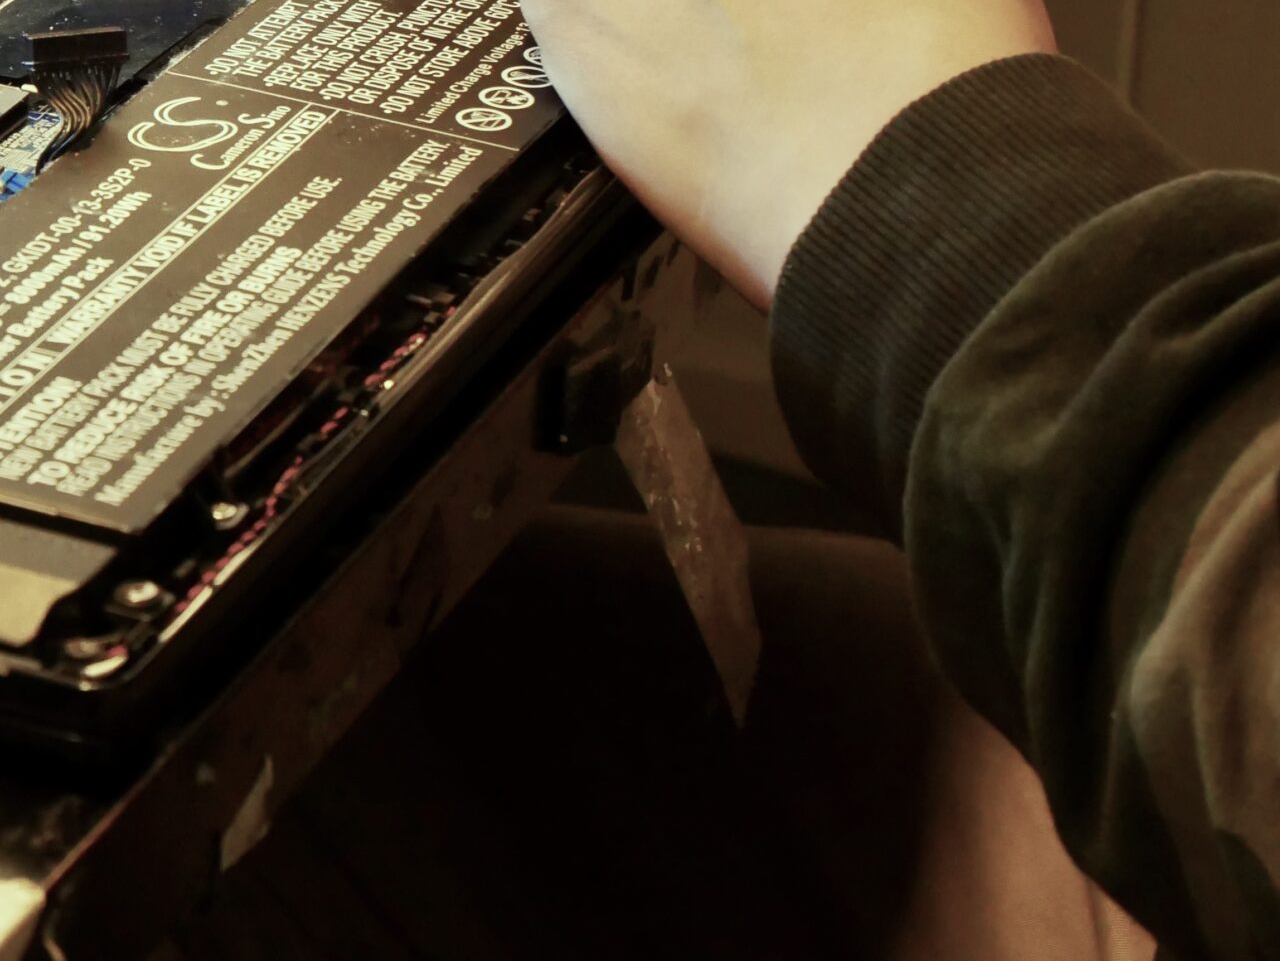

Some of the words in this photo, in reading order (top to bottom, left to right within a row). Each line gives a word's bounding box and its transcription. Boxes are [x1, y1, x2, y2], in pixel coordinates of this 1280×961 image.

[222, 38, 262, 59] NOT
[247, 0, 309, 40] ATTEMPT
[421, 26, 451, 39] IN
[433, 7, 473, 29] FIRE
[232, 57, 273, 77] THE
[254, 19, 317, 60] BATTERY
[263, 43, 329, 86] REPLACE
[312, 21, 354, 45] ONLY
[337, 0, 381, 23] WITH
[289, 71, 330, 92] FOR
[311, 50, 354, 71] THIS
[336, 9, 403, 52] PRODUCT.
[336, 61, 375, 84] NOT
[359, 31, 418, 64] CRUSH,
[396, 75, 435, 97] NOT
[418, 46, 469, 77] STORE
[452, 17, 501, 49] ABOVE
[407, 36, 437, 51] OF
[363, 49, 425, 90] DISPOSE
[347, 88, 382, 104] OR
[415, 91, 461, 124] Limited
[449, 63, 492, 93] Charge
[190, 128, 266, 171] Cameron
[237, 106, 291, 129] Sino
[247, 111, 326, 169] REMOVED
[232, 168, 263, 182] IS
[389, 139, 450, 182] BATTERY.
[186, 184, 249, 224] LABEL
[299, 176, 342, 199] USE.
[368, 179, 407, 200] THE
[79, 192, 152, 242] 91.20Wh
[170, 221, 199, 237] IF
[258, 196, 318, 237] BEFORE
[336, 199, 386, 232] USING
[132, 236, 186, 268] VOID
[205, 235, 275, 285] CHARGED
[294, 229, 354, 272] BEFORE
[6, 286, 80, 337] Battery
[62, 257, 114, 289] Pack
[45, 265, 148, 345] WARRANTY
[169, 282, 221, 316] FULLY
[261, 268, 314, 303] GUIDE
[95, 415, 203, 506] Manufacture
[275, 273, 351, 331] HENZENS
[334, 209, 421, 274] Technology
[402, 189, 443, 210] Co.,
[424, 145, 483, 187] Limited
[152, 313, 188, 333] BE
[198, 301, 279, 362] OPERATING
[27, 461, 71, 486] TO
[54, 398, 138, 464] REDUCE
[120, 363, 176, 402] RISK
[159, 341, 194, 366] OF
[180, 310, 232, 345] FIRE
[216, 291, 255, 313] OR
[238, 246, 302, 293] BURNS
[116, 329, 169, 366] MUST
[183, 358, 216, 376] IN
[82, 362, 135, 397] PACK
[25, 392, 99, 450] BATTERY
[95, 372, 202, 460] INSTRUCTIONS
[56, 457, 112, 496] READ
